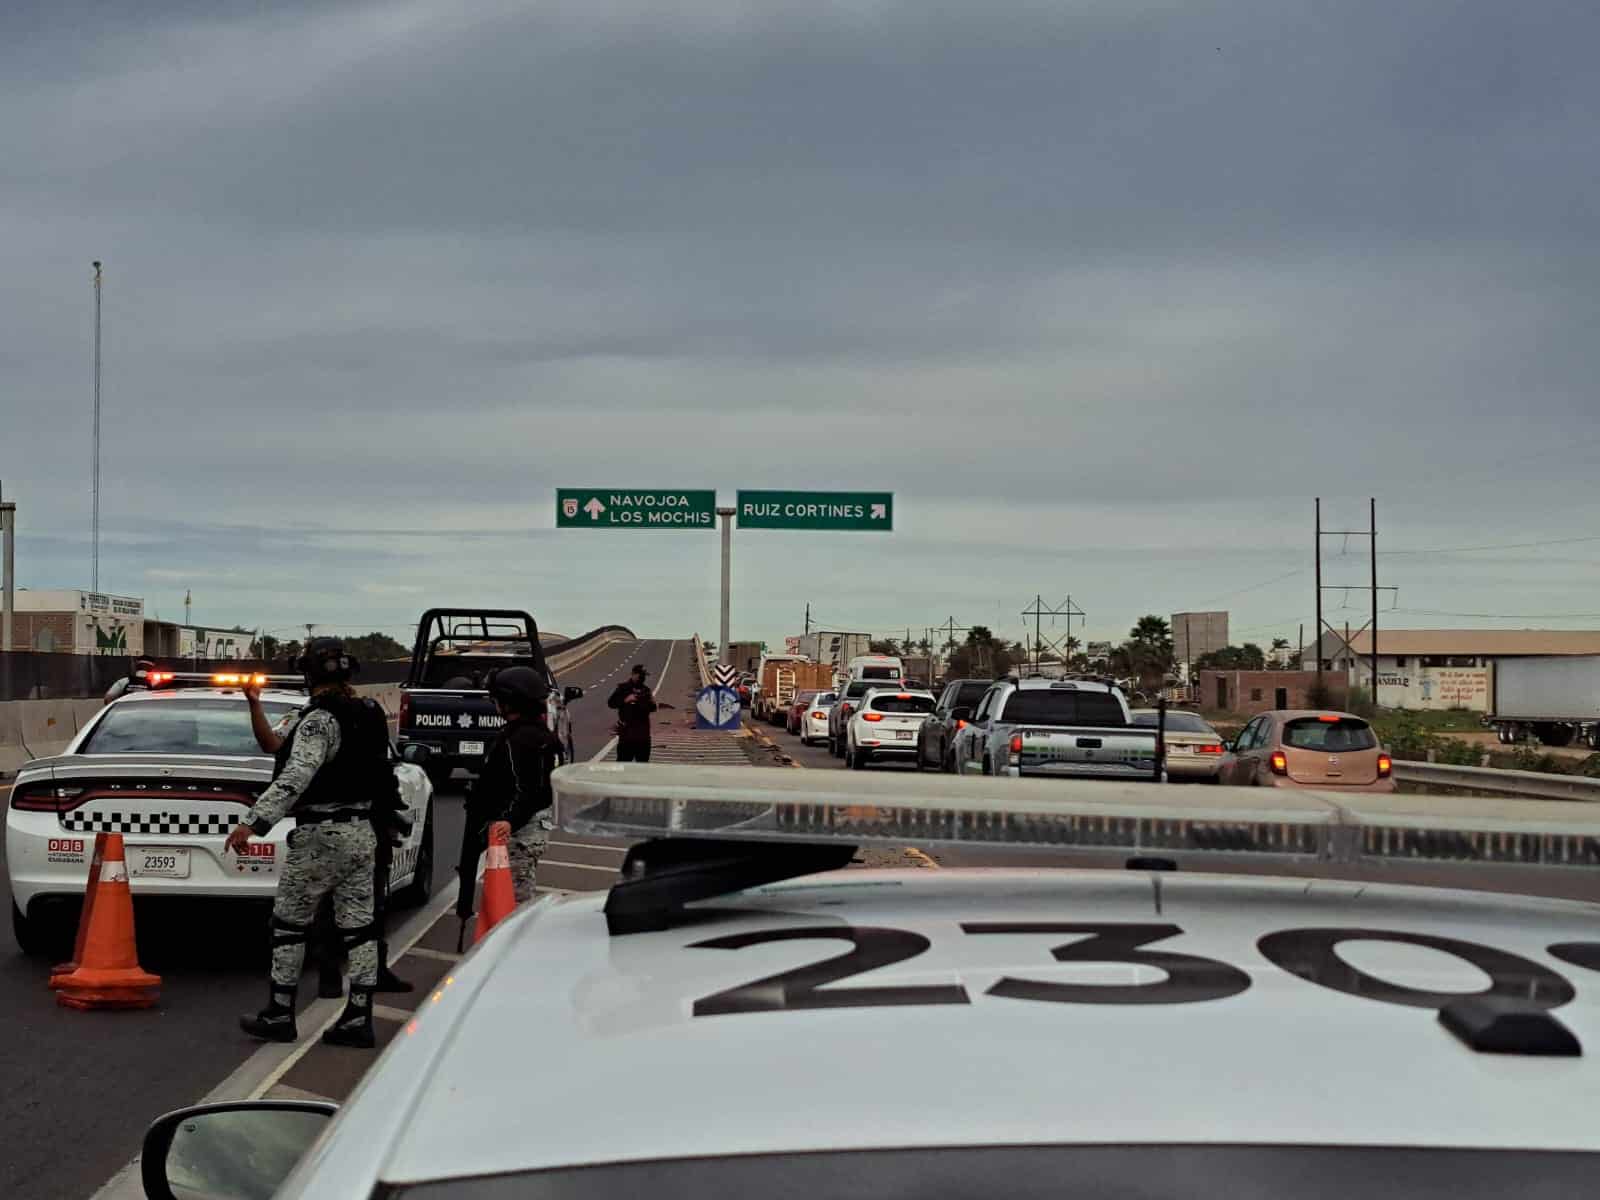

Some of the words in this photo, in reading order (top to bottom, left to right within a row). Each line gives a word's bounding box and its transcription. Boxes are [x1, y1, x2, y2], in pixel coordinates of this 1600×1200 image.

[609, 495, 690, 506] NAVOJOA
[743, 503, 781, 516] RUIZ
[784, 503, 865, 518] CORTINES
[609, 511, 643, 523] LOS
[648, 511, 711, 524] MOCHIS
[415, 713, 452, 727] POLICIA
[49, 840, 82, 851] 088
[144, 856, 176, 868] 23593
